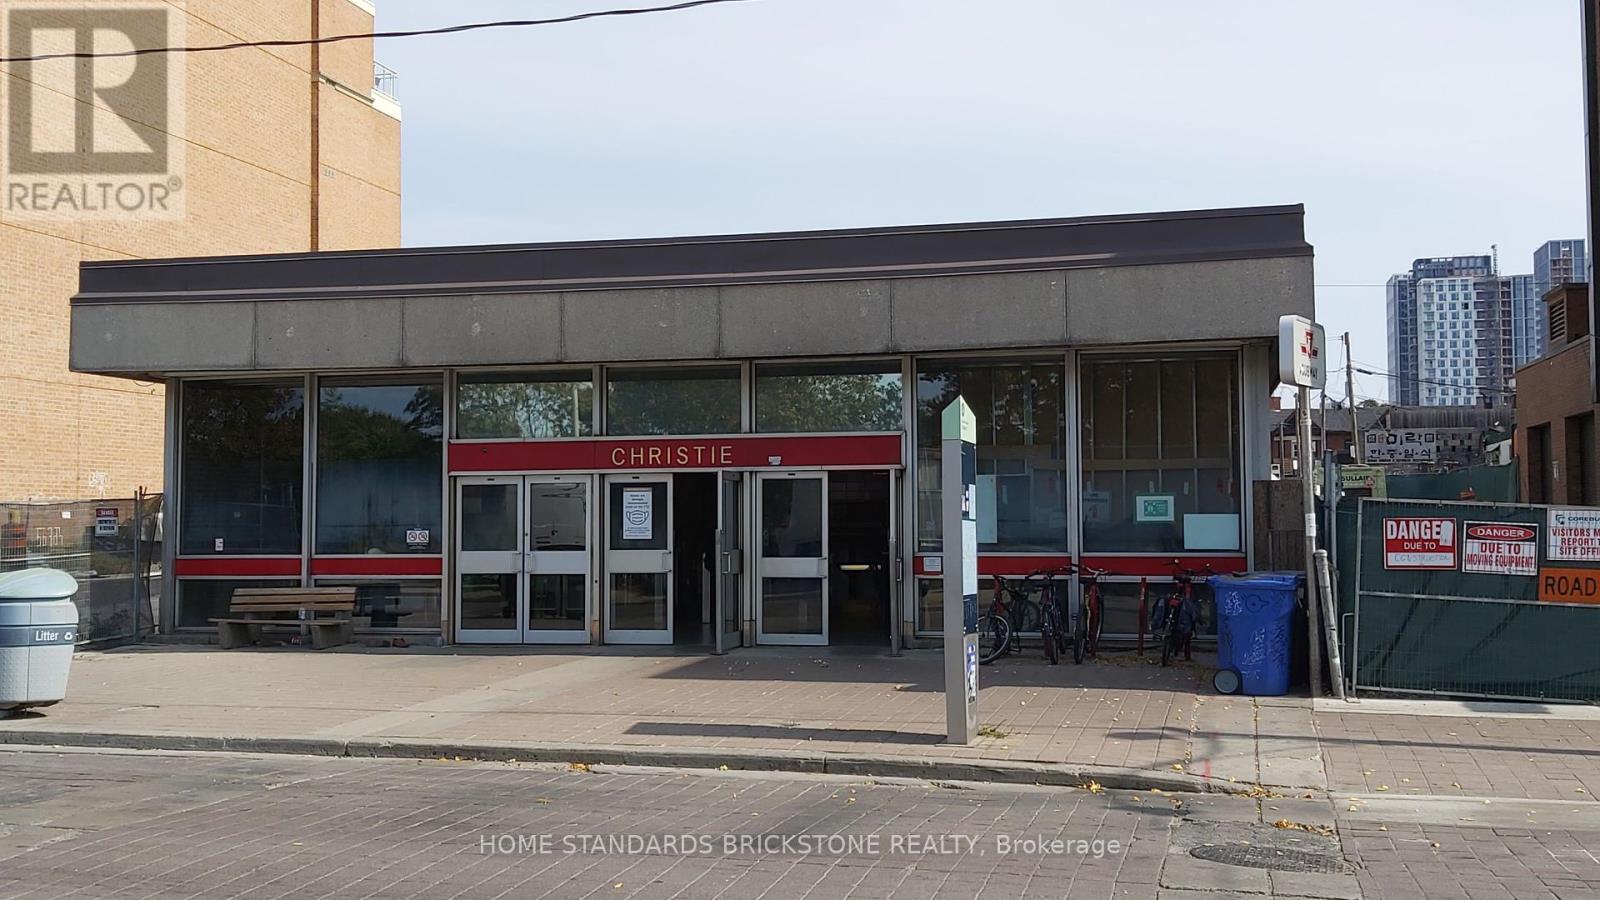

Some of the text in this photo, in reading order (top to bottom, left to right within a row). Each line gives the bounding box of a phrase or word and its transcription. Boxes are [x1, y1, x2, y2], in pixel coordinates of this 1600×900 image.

[611, 446, 733, 466] CHRISTIE
[1386, 520, 1453, 540] DANGE
[1477, 528, 1525, 538] DANGER
[1552, 528, 1591, 537] VISITORS
[1403, 541, 1436, 550] DUE TO
[1561, 538, 1595, 547] REPORT
[1480, 542, 1521, 555] DUE TO
[1559, 547, 1578, 556] SITE
[1467, 553, 1534, 569] MOVING EQUIPMENT
[1544, 575, 1597, 597] ROAD
[35, 630, 60, 641] Litter
